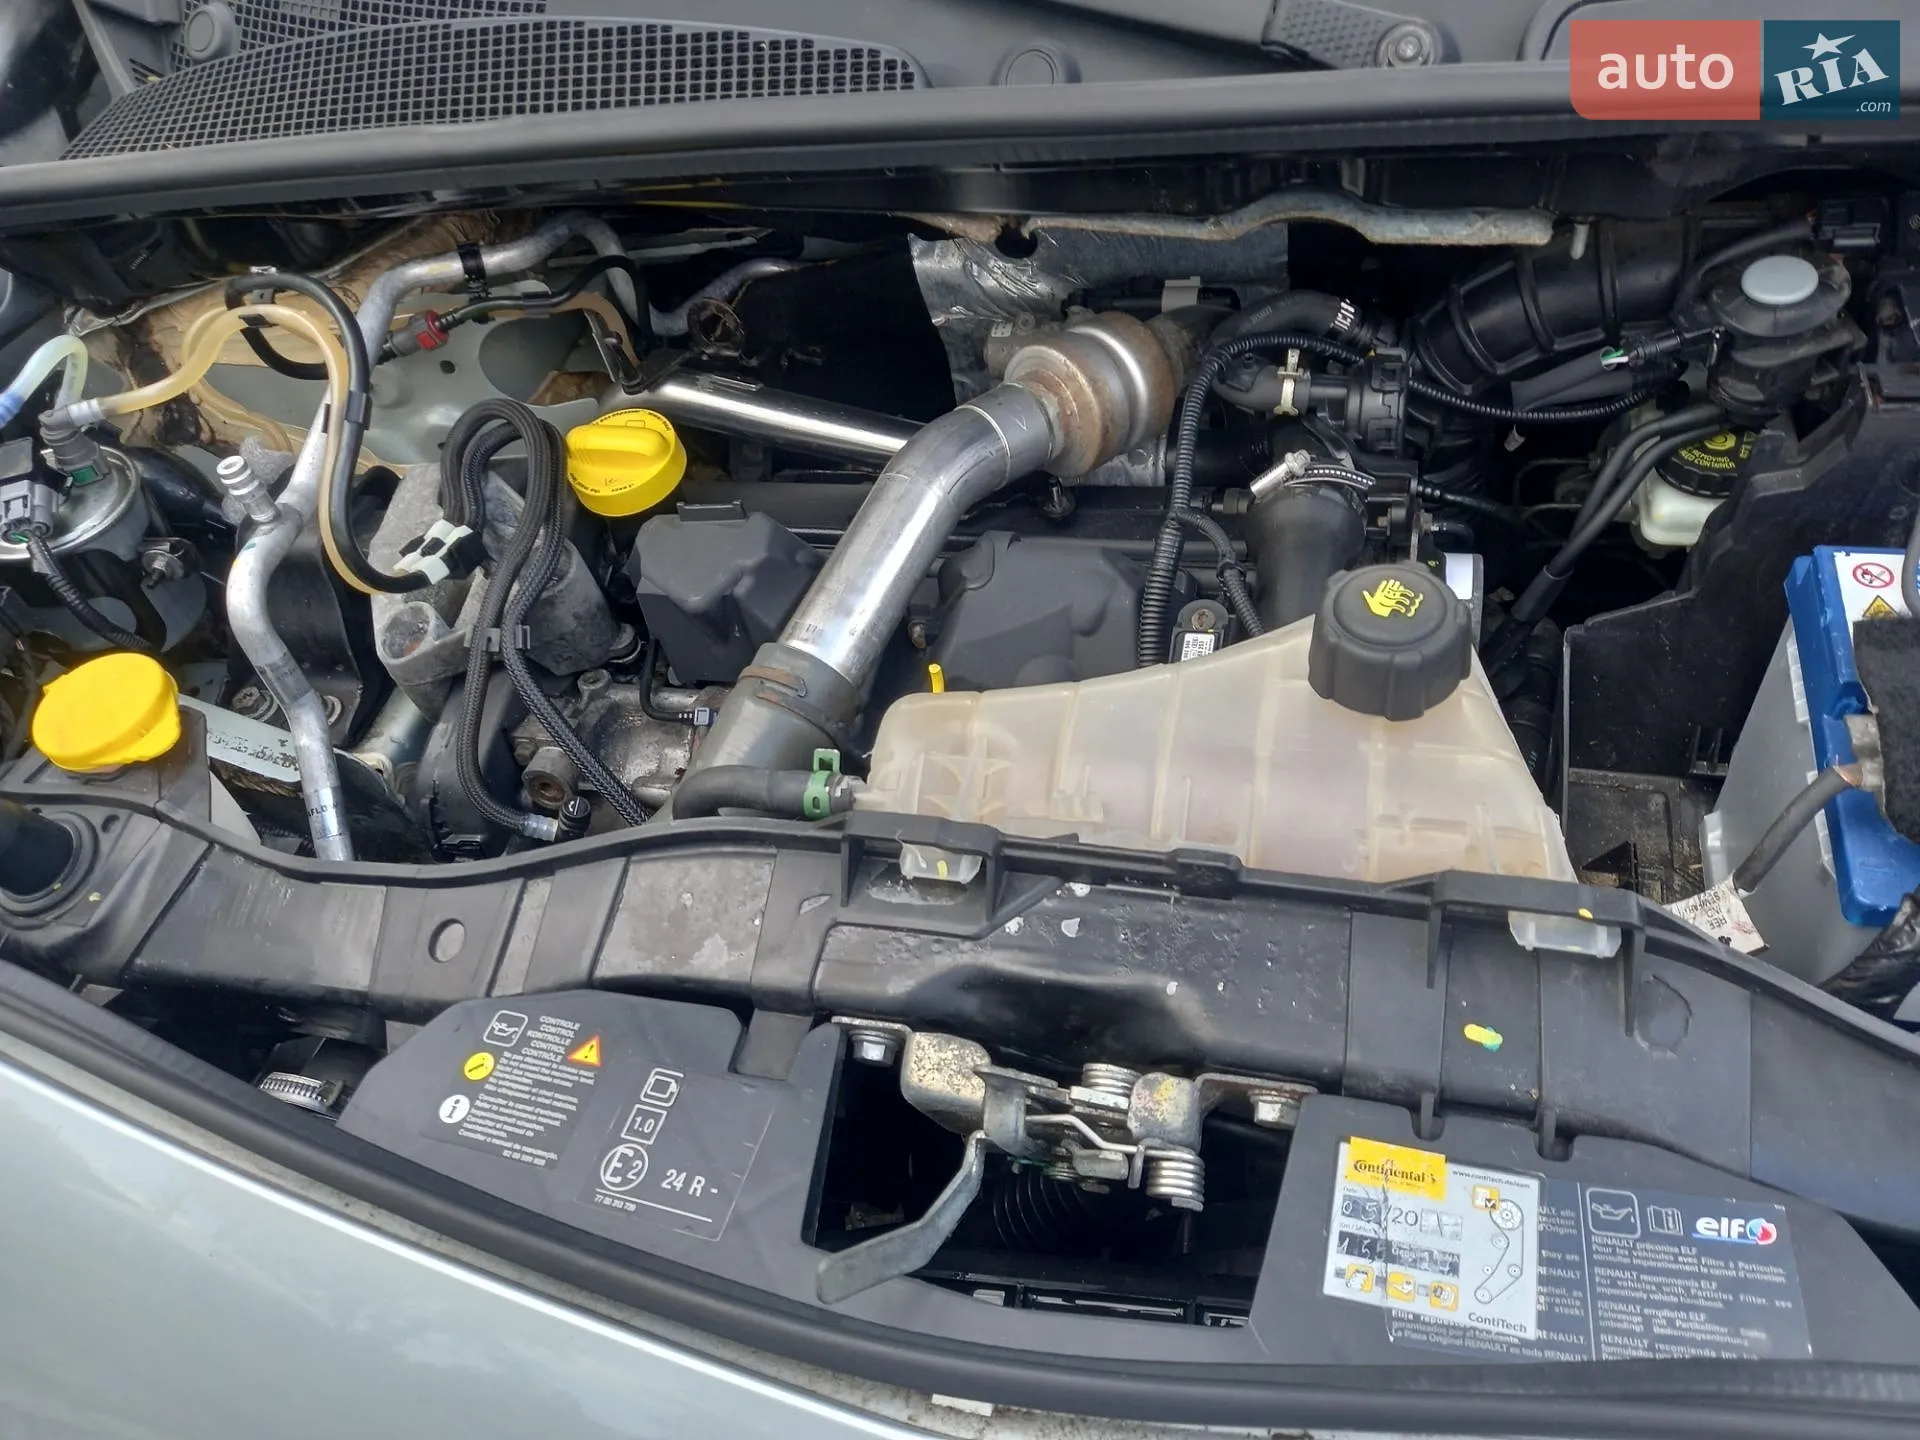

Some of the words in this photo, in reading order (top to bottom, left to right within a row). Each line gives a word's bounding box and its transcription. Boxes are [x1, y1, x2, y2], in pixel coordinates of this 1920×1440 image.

[633, 1116, 655, 1134] 1.0
[660, 1168, 687, 1192] 24
[688, 1175, 706, 1197] R
[1695, 1216, 1746, 1239] elf
[1591, 1234, 1635, 1249] RENAULT
[1594, 1266, 1638, 1280] RENAULT
[1597, 1299, 1641, 1314] RENAULT
[1467, 1311, 1528, 1334] ContiTech
[1464, 1340, 1509, 1353] RENAULT
[1600, 1333, 1650, 1349] RENAULT
